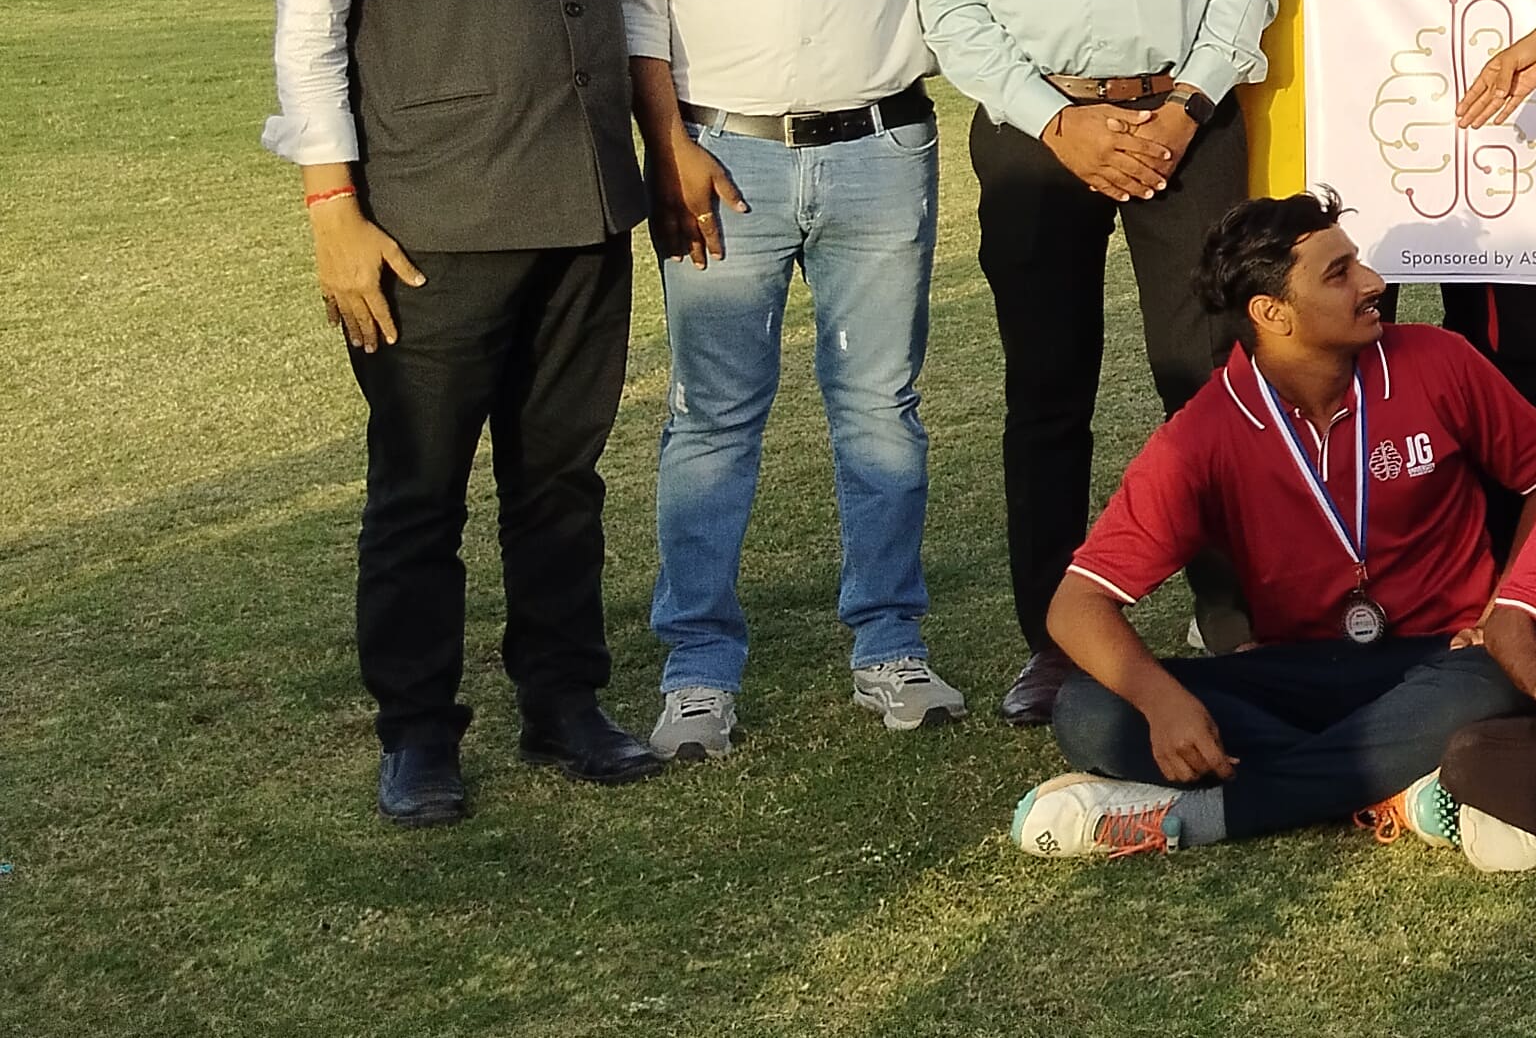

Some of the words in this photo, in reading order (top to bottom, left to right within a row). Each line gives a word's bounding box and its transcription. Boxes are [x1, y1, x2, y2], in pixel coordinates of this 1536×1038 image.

[1401, 250, 1488, 268] Sponsored
[1494, 251, 1514, 268] by
[1405, 432, 1434, 468] JG
